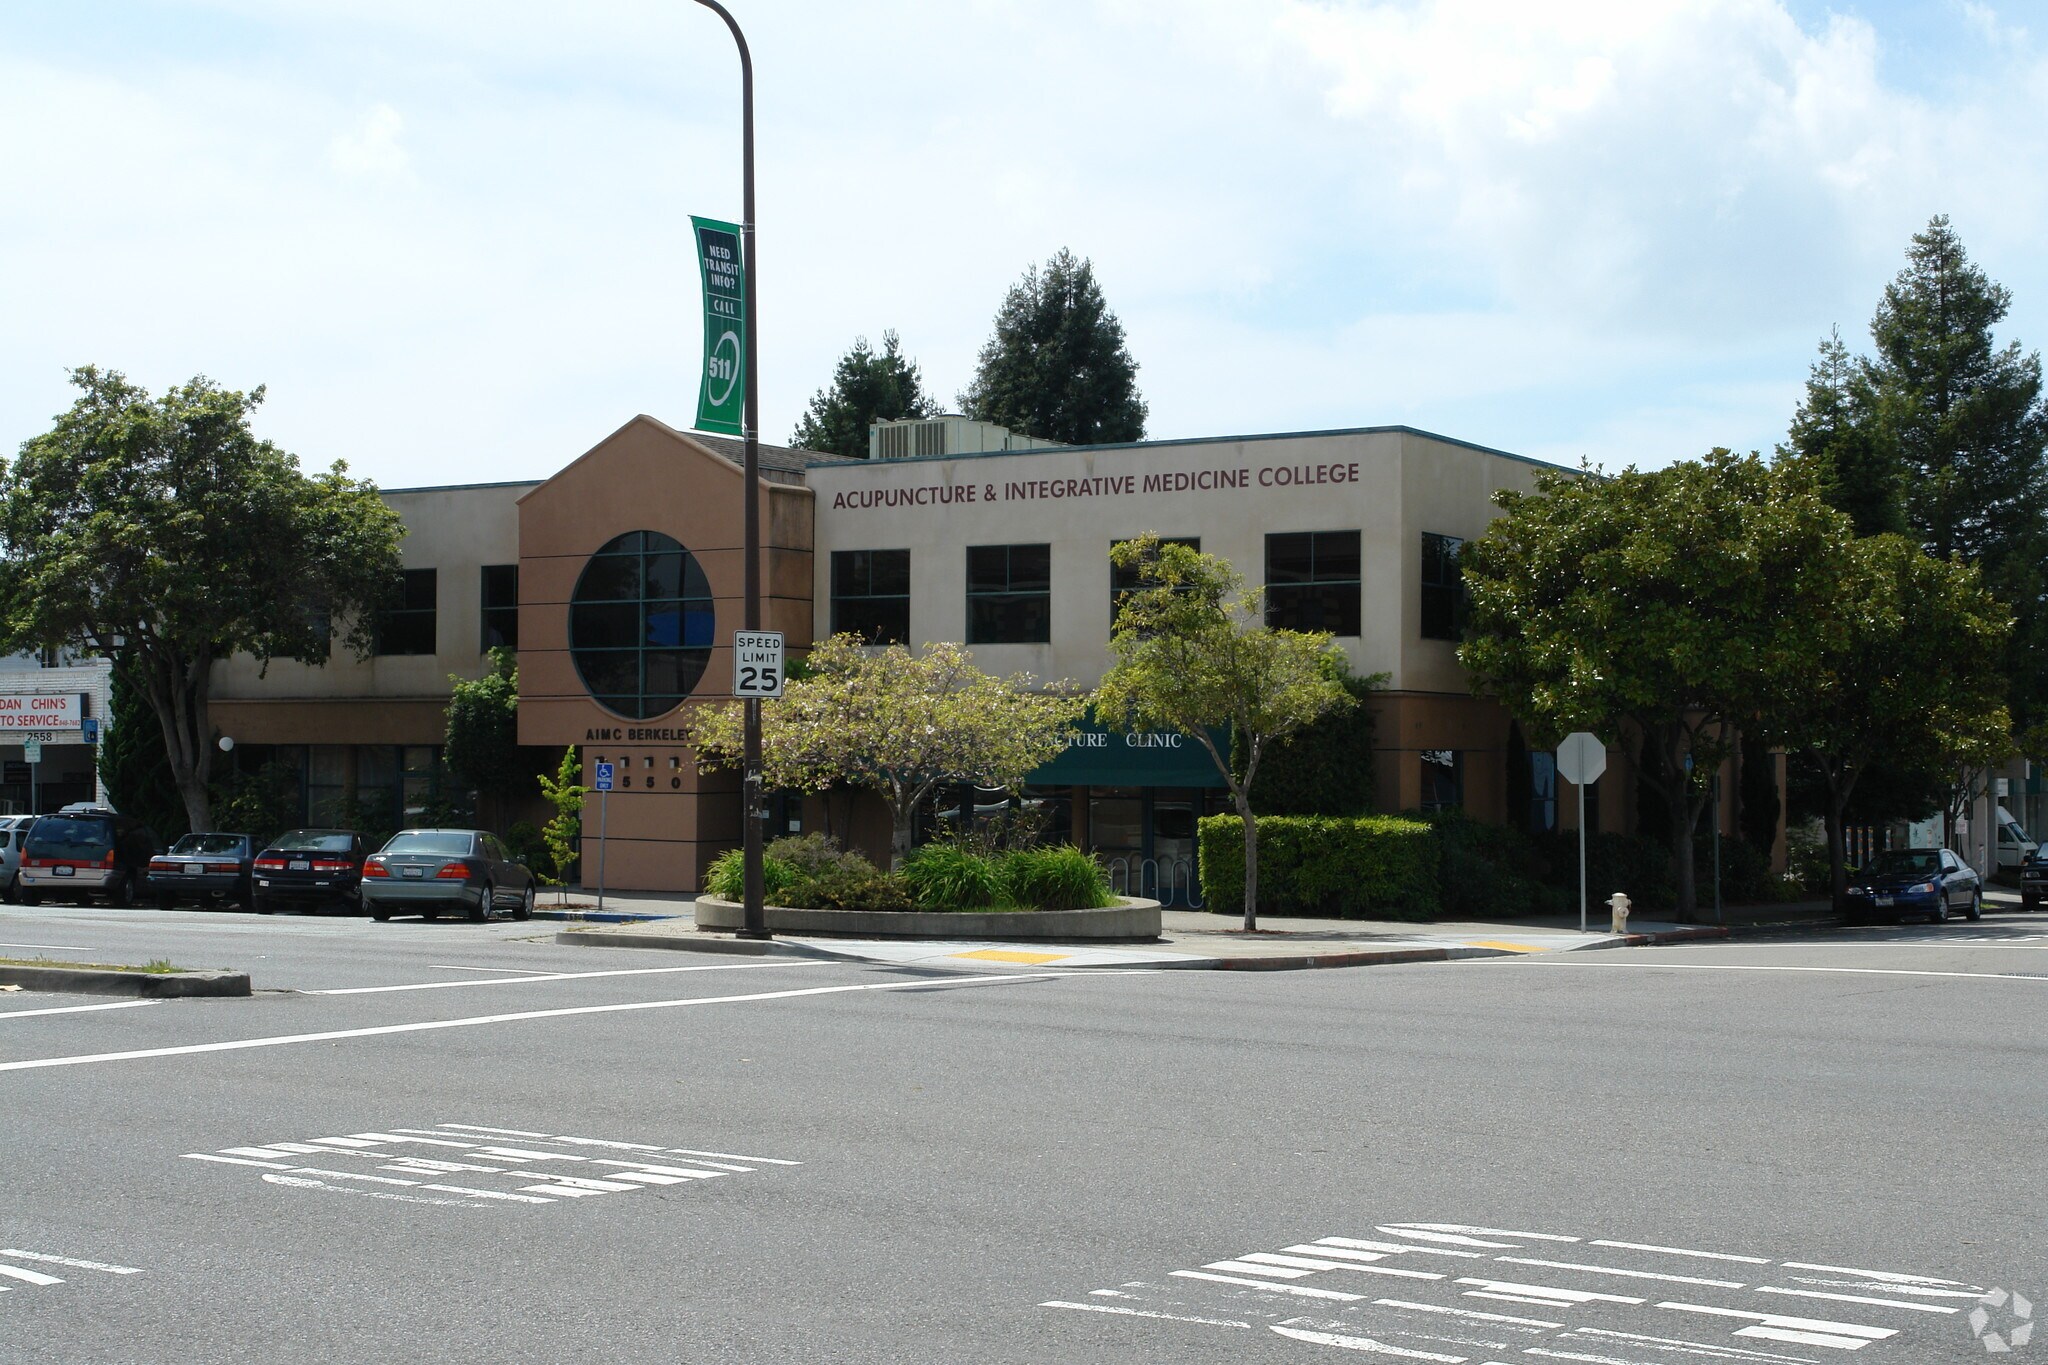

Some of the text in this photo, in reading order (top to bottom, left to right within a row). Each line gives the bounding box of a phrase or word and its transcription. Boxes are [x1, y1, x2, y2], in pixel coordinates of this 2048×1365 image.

[709, 245, 731, 260] NEED
[704, 257, 739, 276] TRANSIT
[711, 273, 736, 290] INFO?
[713, 299, 735, 315] CALL
[708, 356, 730, 380] 511
[833, 462, 1360, 510] ACUPUNCTURE & INTEGRATIVE MEDICINE COLLEGE
[738, 637, 781, 649] SPEED
[742, 652, 777, 663] LIMIT
[739, 666, 778, 692] 25
[31, 698, 66, 710] CHIN'S
[17, 715, 59, 726] SERVICE
[27, 732, 52, 741] 2558
[586, 728, 693, 741] AIMC BERKELEY
[1125, 732, 1182, 748] CLINIC
